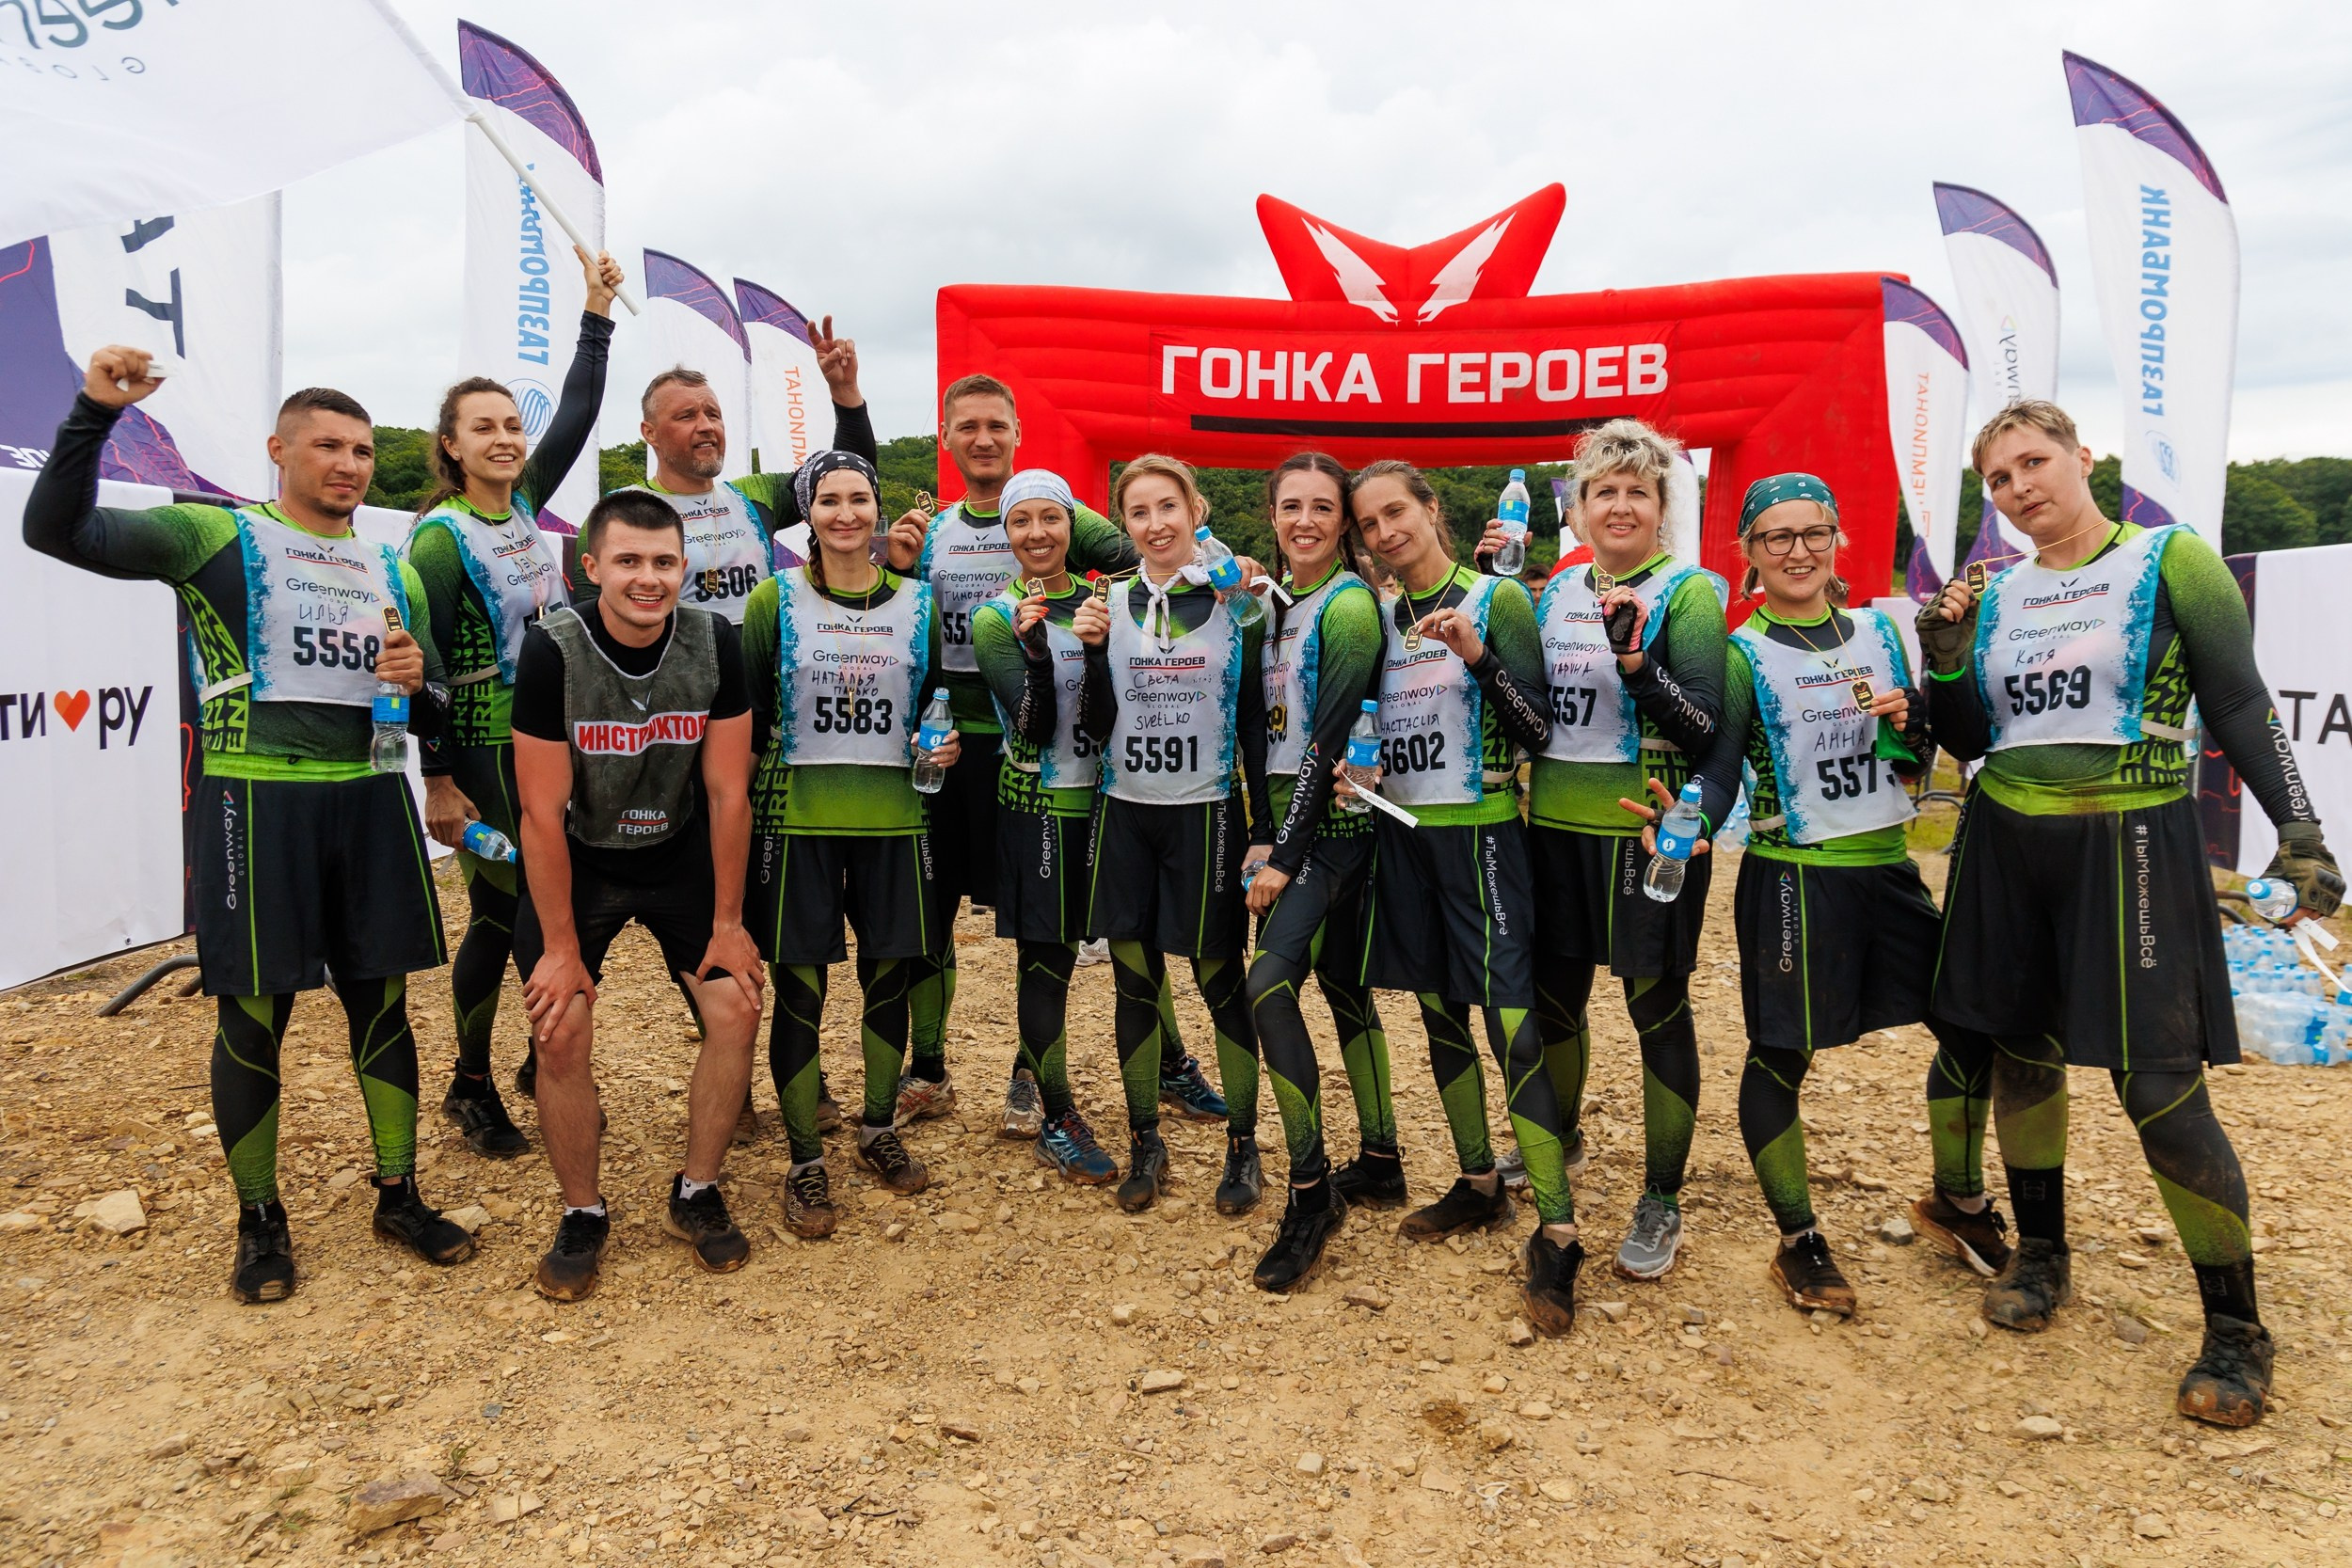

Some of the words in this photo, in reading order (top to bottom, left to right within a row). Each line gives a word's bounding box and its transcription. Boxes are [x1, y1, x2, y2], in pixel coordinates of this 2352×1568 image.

[1162, 344, 1382, 404] ГОНКА
[1406, 342, 1669, 404] ГЕРОЕВ
[285, 547, 326, 562] ГОНКА
[938, 569, 1003, 585] Greenway
[285, 578, 371, 603] Greenway
[2023, 594, 2060, 607] ГОНКА
[2063, 583, 2110, 600] ГЕРОЕВ
[817, 623, 851, 632] ГОНКА
[2009, 619, 2094, 641] Greenway
[293, 626, 380, 674] 5558
[1060, 649, 1085, 658] ГОНК
[1408, 649, 1448, 663] ГЕРОЕВ
[1545, 637, 1600, 654] Greenway
[813, 649, 889, 667] Greenway
[1129, 657, 1162, 666] ГОНКА
[1165, 656, 1206, 666] ГЕРОЕВ
[1794, 673, 1833, 686] ГОНКА
[1835, 665, 1873, 679] ГЕРОЕВ
[1125, 689, 1197, 704] Greenway
[1379, 685, 1437, 705] Greenway
[2004, 664, 2092, 717] 5569
[813, 696, 893, 735] 5583
[1495, 669, 1549, 741] Greenway
[1802, 705, 1861, 723] Greenw
[99, 685, 153, 751] ру
[1124, 735, 1198, 773] 5591
[1380, 731, 1446, 777] 5602
[1816, 752, 1896, 801] 557
[2269, 725, 2310, 821] reenway
[1276, 754, 1318, 844] Greenway
[621, 809, 667, 820] ГОНКА
[617, 822, 669, 835] ГЕРОЕВ
[222, 806, 238, 910] Greenway
[1779, 882, 1793, 973] Greenway
